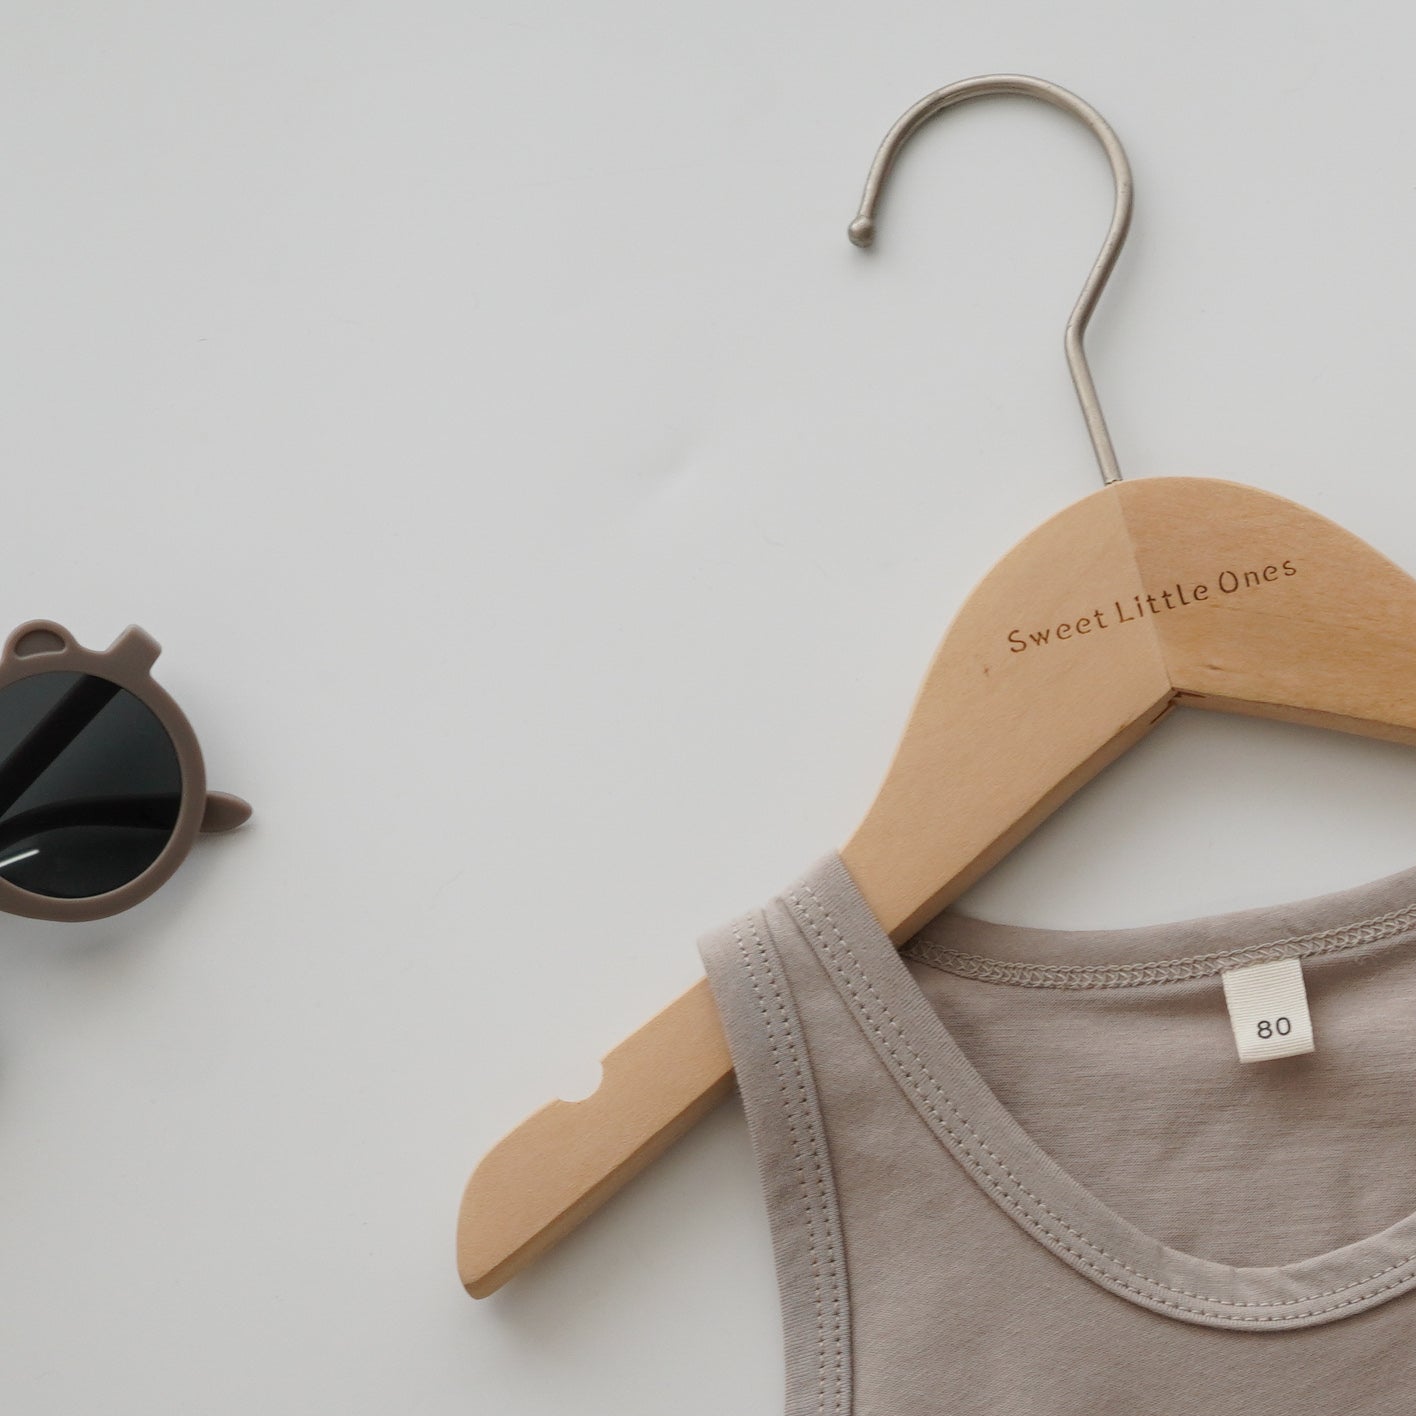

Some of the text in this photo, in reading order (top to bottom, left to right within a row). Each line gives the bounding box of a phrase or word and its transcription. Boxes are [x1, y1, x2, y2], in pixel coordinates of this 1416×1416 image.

[1007, 559, 1297, 653] Sweet Little Ones
[1257, 1017, 1291, 1039] 80
